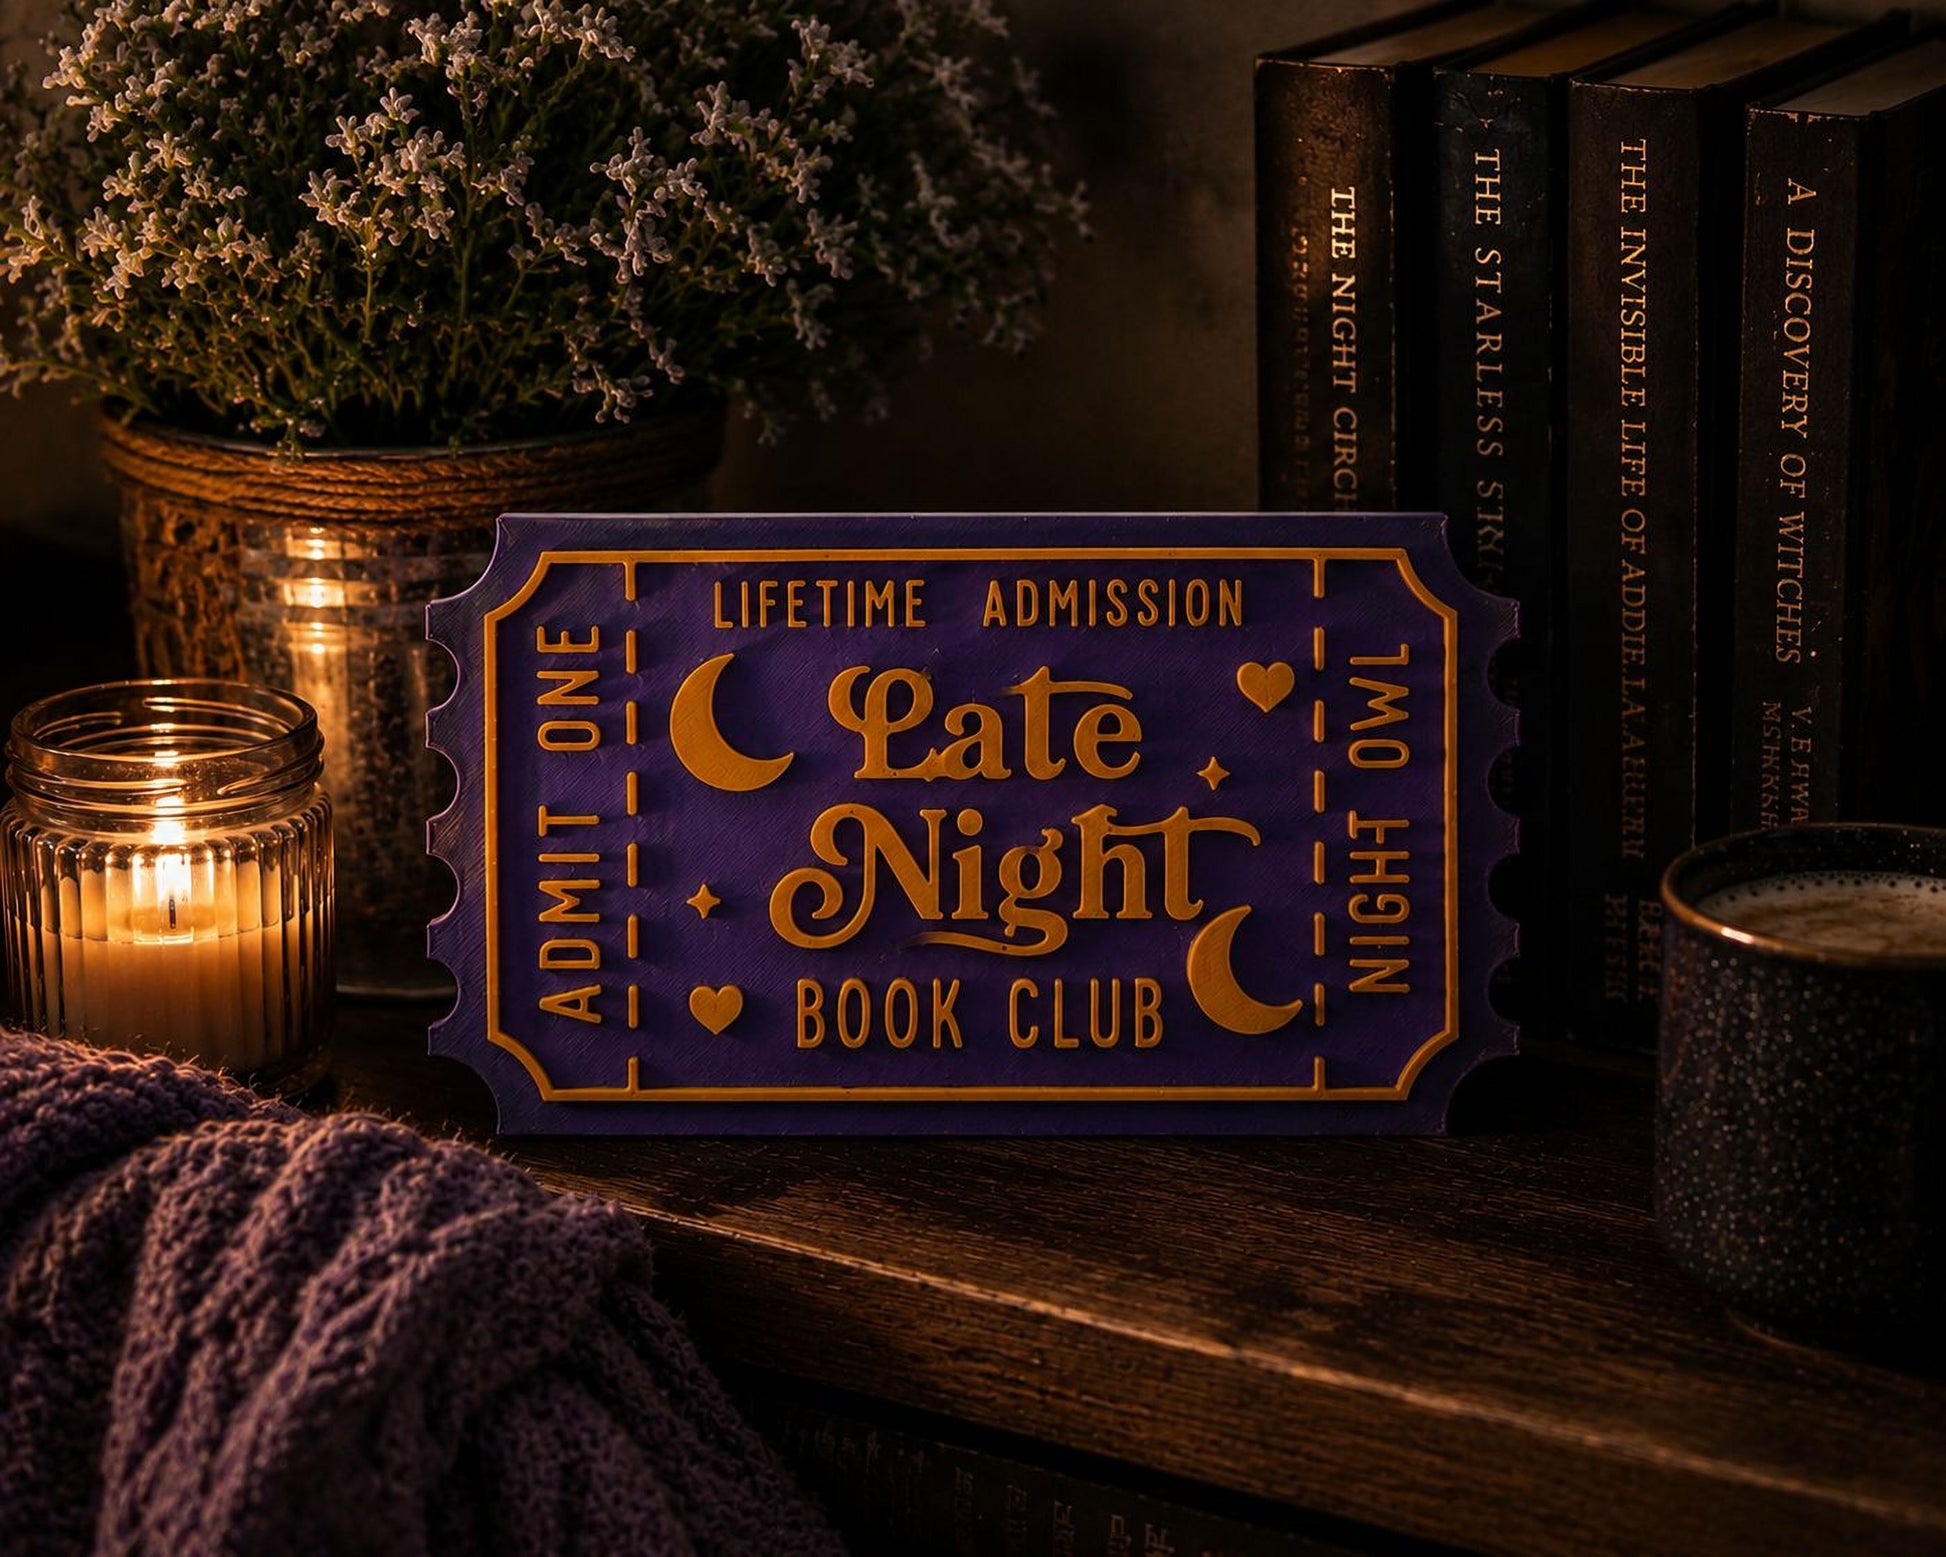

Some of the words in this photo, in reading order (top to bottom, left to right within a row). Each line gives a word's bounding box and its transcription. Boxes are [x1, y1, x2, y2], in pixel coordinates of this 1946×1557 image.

[1329, 186, 1357, 260] THE
[1474, 148, 1501, 226] THE
[1620, 138, 1648, 214] THE
[1786, 177, 1818, 206] A
[1330, 271, 1358, 394] NIGHT
[1474, 246, 1504, 457] STARLESS
[1620, 224, 1648, 408] INVISIBLE
[1780, 227, 1816, 440] DISCOVERY
[1620, 418, 1648, 498] LIFE
[1778, 452, 1808, 500] OF
[1620, 507, 1648, 556] OF
[1775, 510, 1806, 665] WITCHES
[713, 579, 927, 630] LIFETIME
[982, 578, 1243, 629] ADMISSION
[535, 623, 601, 753] ONE
[827, 664, 1143, 783] Late
[1348, 642, 1411, 770] OWL
[537, 804, 603, 1024] ADMIT
[768, 802, 1262, 957] Night
[1348, 809, 1411, 993] NIGHT
[795, 977, 963, 1049] BOOK
[1008, 977, 1164, 1049] CLUB
